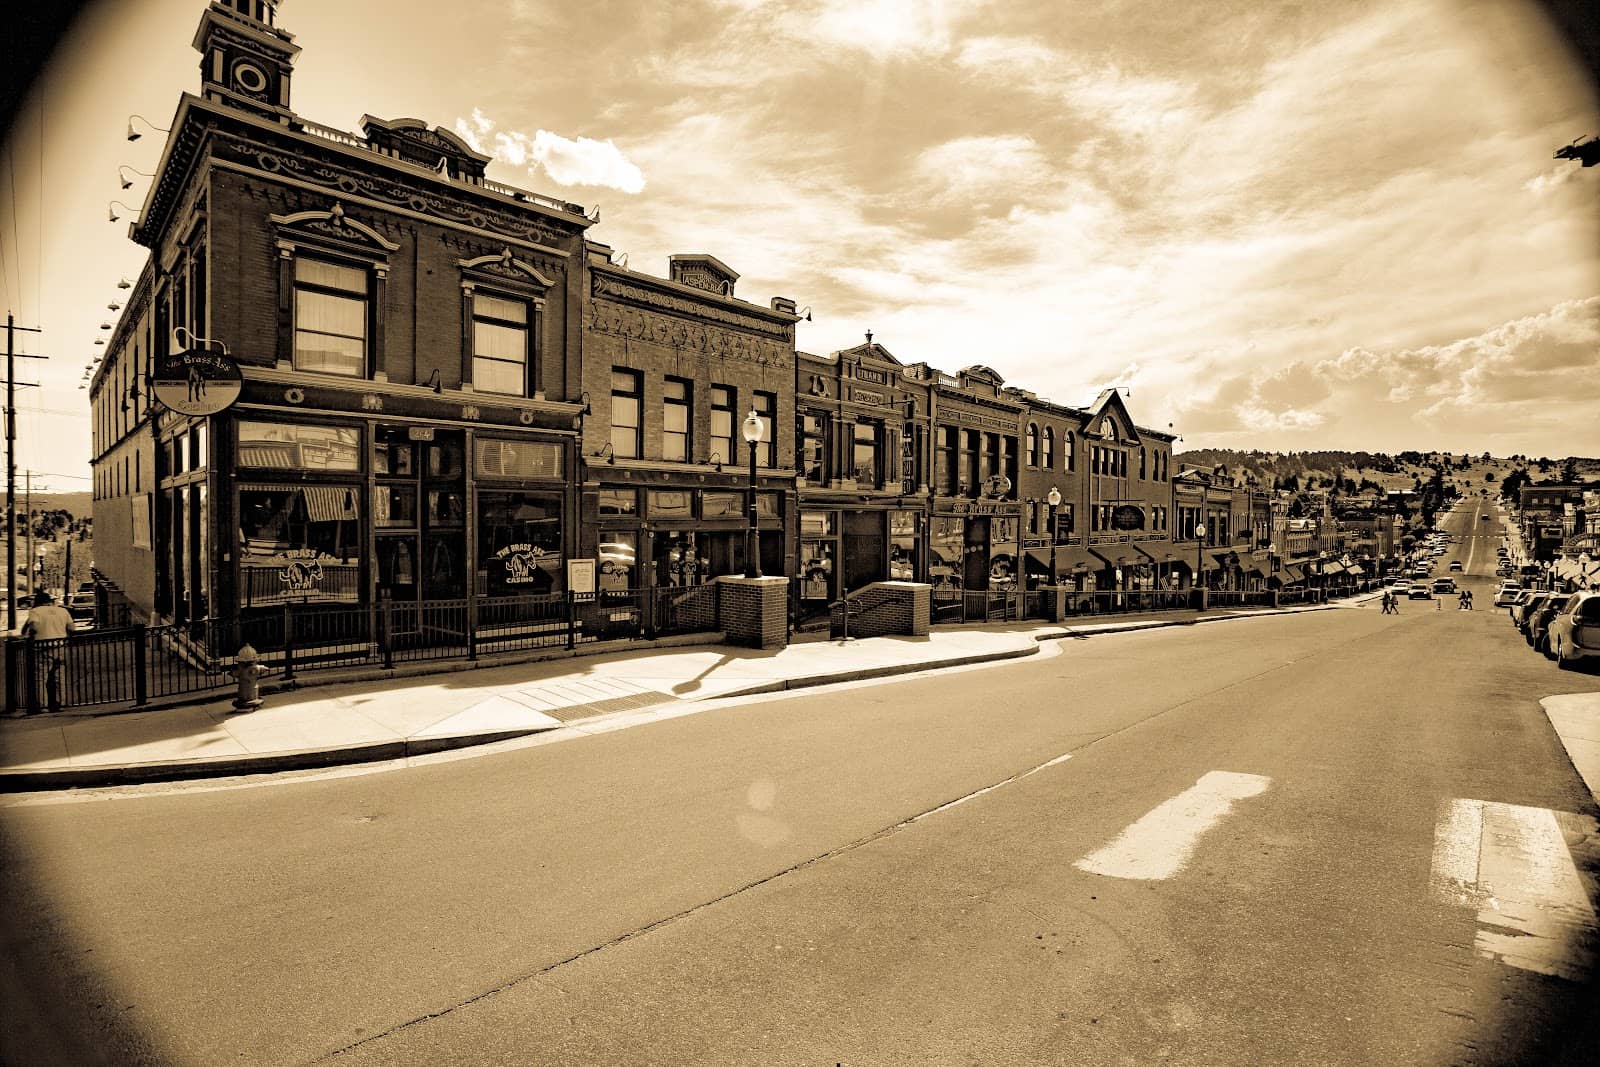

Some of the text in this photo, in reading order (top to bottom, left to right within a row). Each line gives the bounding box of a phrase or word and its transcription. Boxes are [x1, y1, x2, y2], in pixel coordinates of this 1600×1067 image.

[183, 354, 212, 365] Brass
[286, 548, 317, 559] BRASS
[496, 546, 510, 559] THE
[510, 543, 531, 552] BRASS
